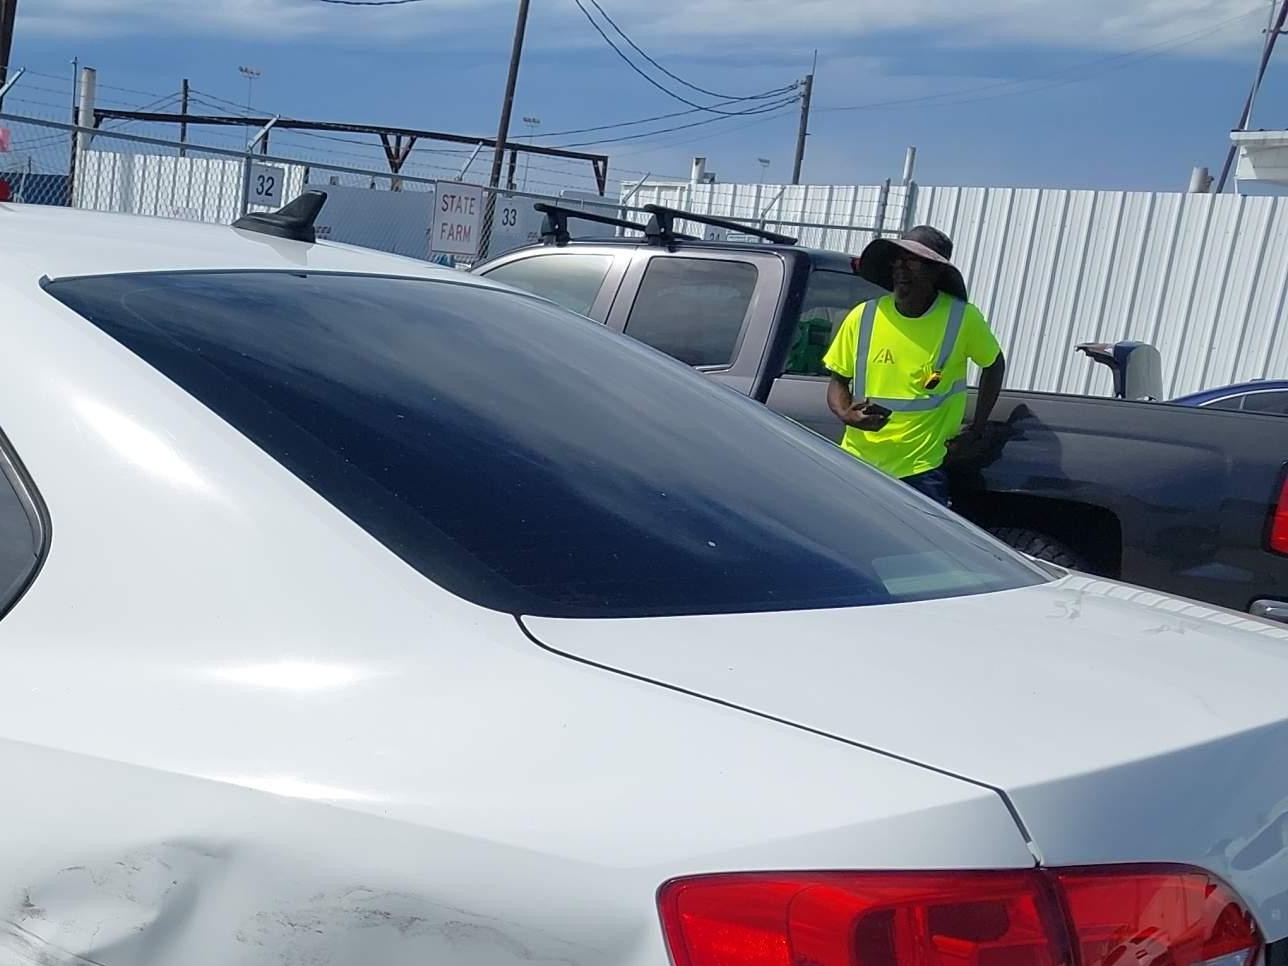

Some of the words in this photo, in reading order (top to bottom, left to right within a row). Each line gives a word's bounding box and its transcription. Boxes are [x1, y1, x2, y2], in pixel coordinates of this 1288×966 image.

[256, 175, 274, 197] 32
[441, 194, 476, 215] STATE
[502, 208, 517, 226] 33
[440, 223, 472, 240] FARM
